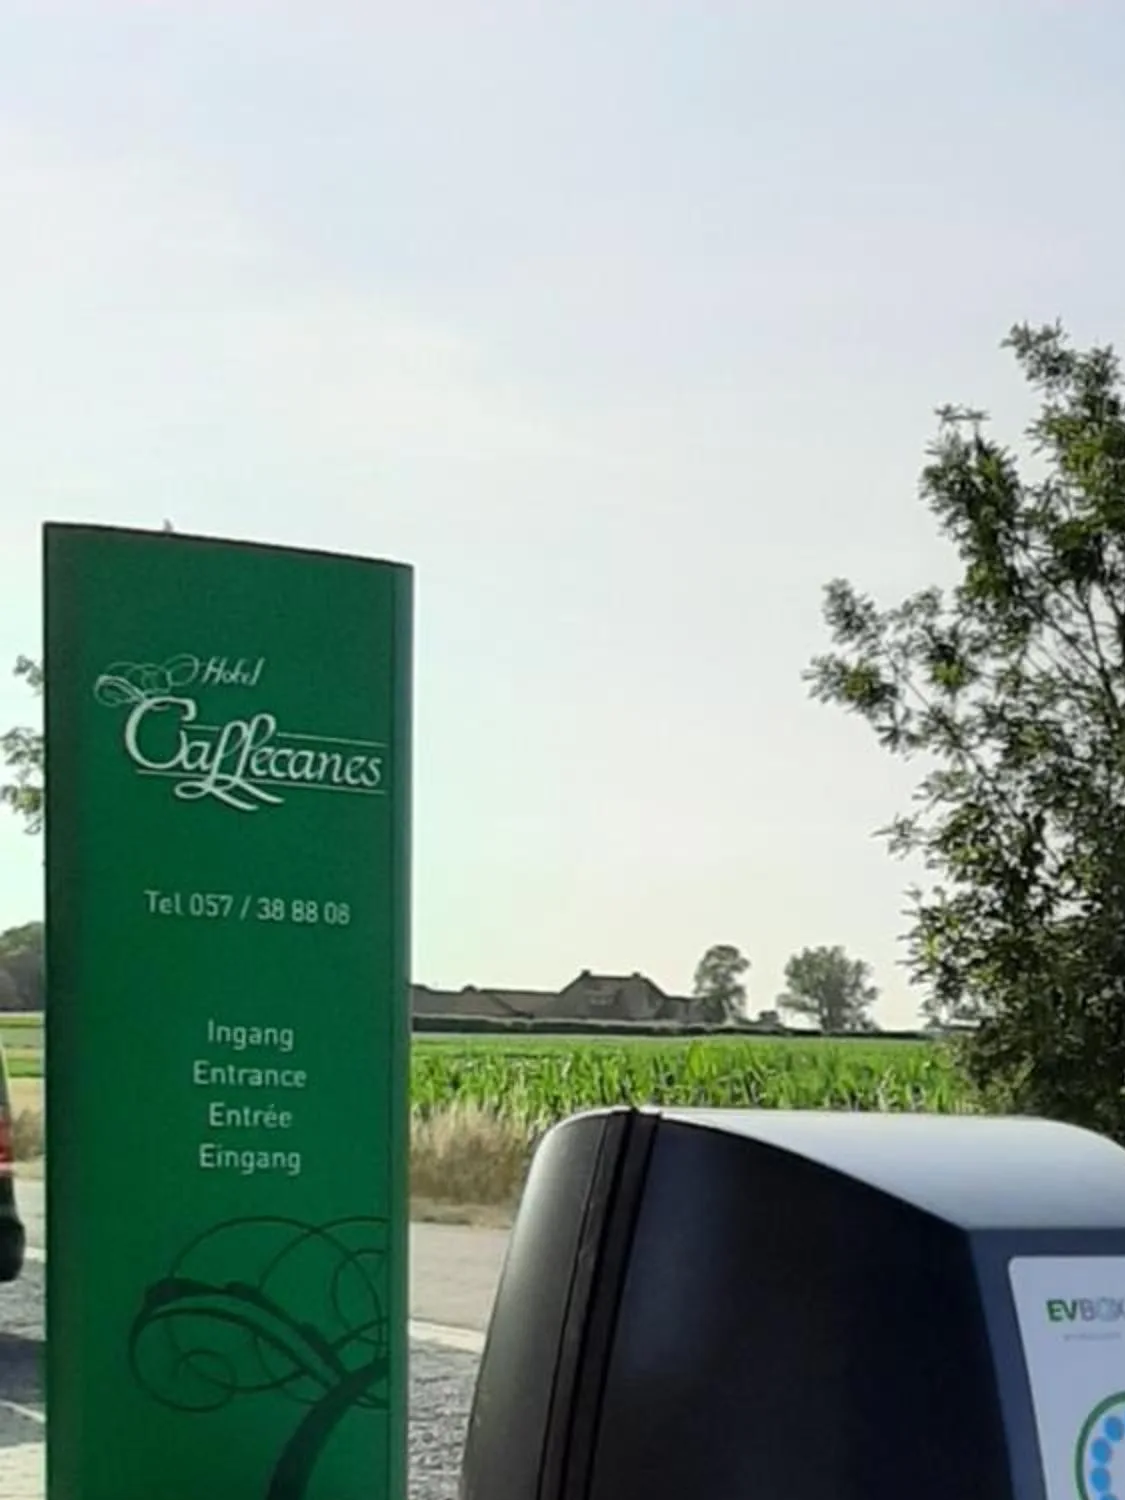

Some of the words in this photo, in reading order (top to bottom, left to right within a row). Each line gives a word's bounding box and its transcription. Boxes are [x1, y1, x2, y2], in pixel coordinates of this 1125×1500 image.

[201, 656, 266, 687] Hotel
[144, 889, 184, 915] Tel
[189, 893, 233, 918] 057
[256, 897, 286, 921] 38
[291, 900, 319, 923] 88
[323, 901, 351, 925] 08
[207, 1019, 294, 1051] Ingang
[192, 1060, 307, 1088] Entrance
[208, 1102, 293, 1128] Entrée
[199, 1143, 302, 1175] Eingang
